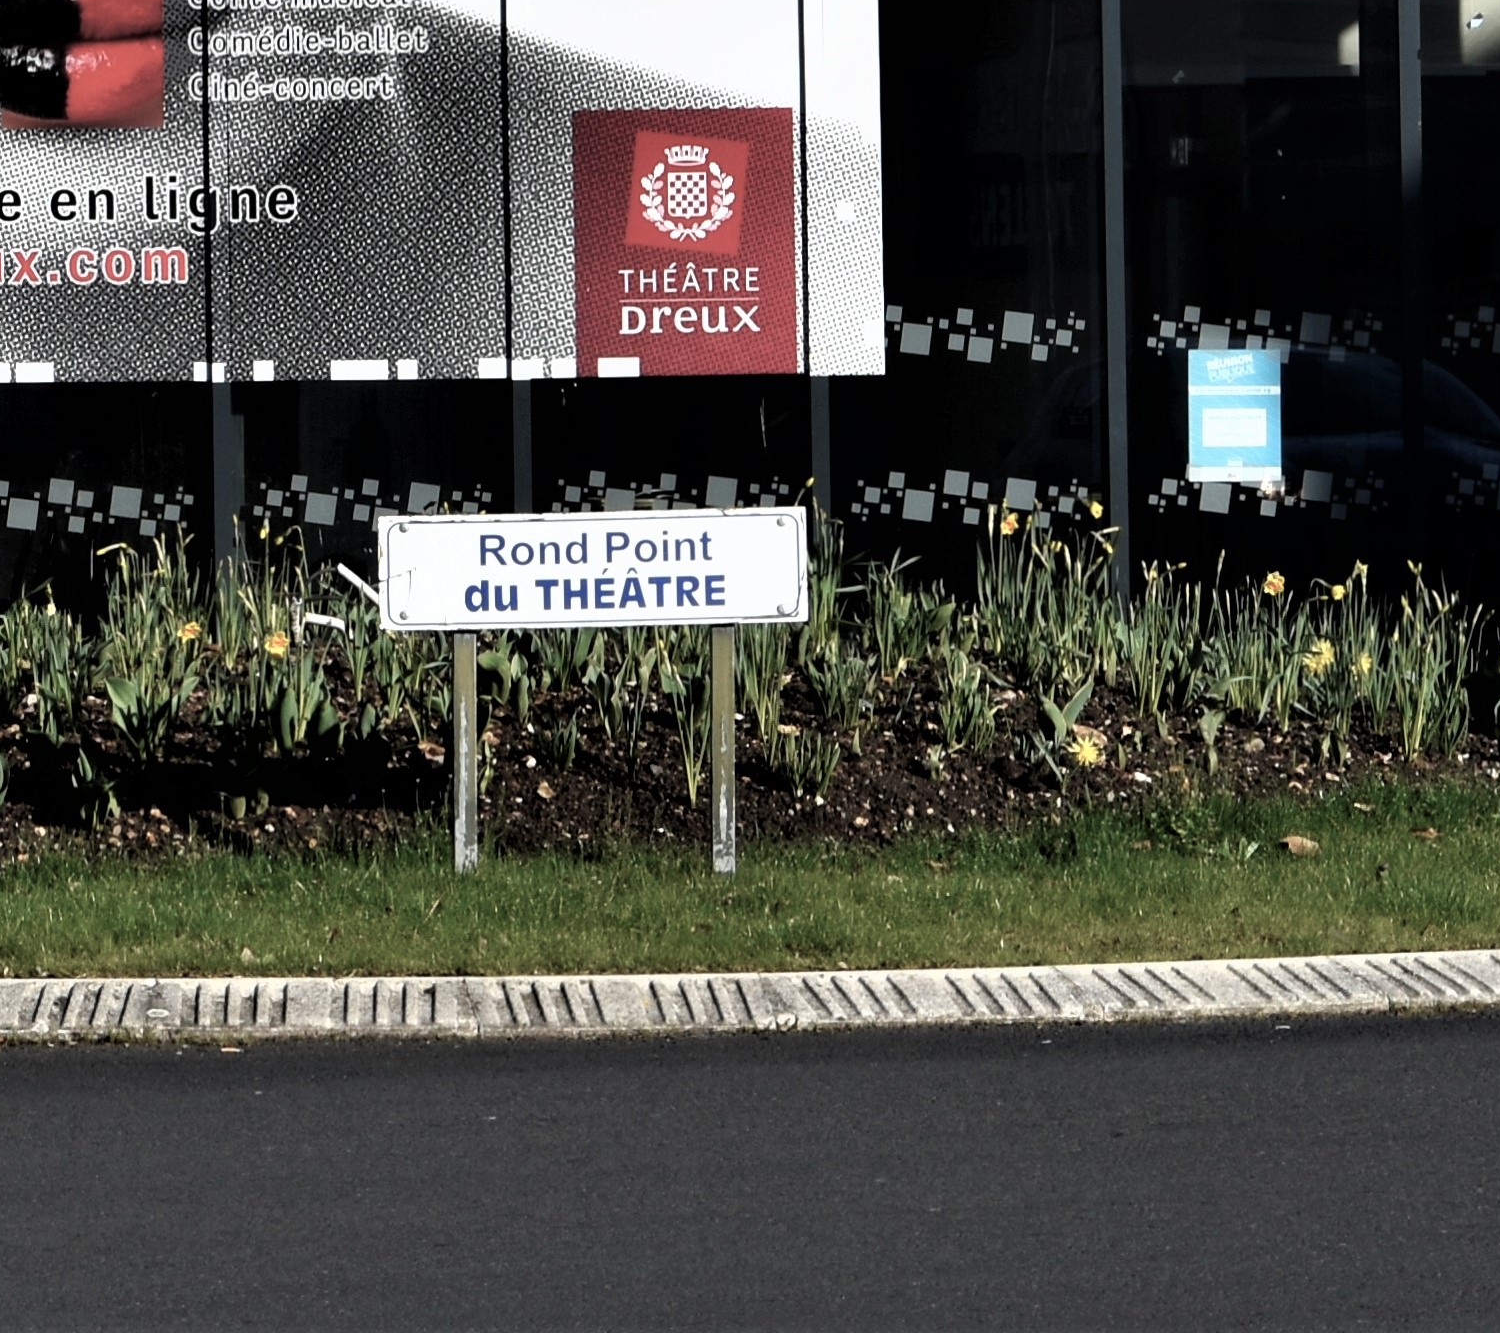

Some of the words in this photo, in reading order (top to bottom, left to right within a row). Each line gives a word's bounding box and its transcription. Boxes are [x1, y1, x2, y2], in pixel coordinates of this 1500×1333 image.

[188, 26, 430, 55] Comédie-ballet
[188, 73, 395, 102] Ciné-concert
[49, 185, 115, 222] en
[145, 175, 298, 233] ligne
[618, 261, 760, 294] THÉÂTRE
[619, 304, 761, 334] Dreux
[479, 532, 589, 566] Rond
[605, 530, 713, 564] Point
[464, 579, 519, 613] du
[535, 567, 727, 610] THÉÂTRE
